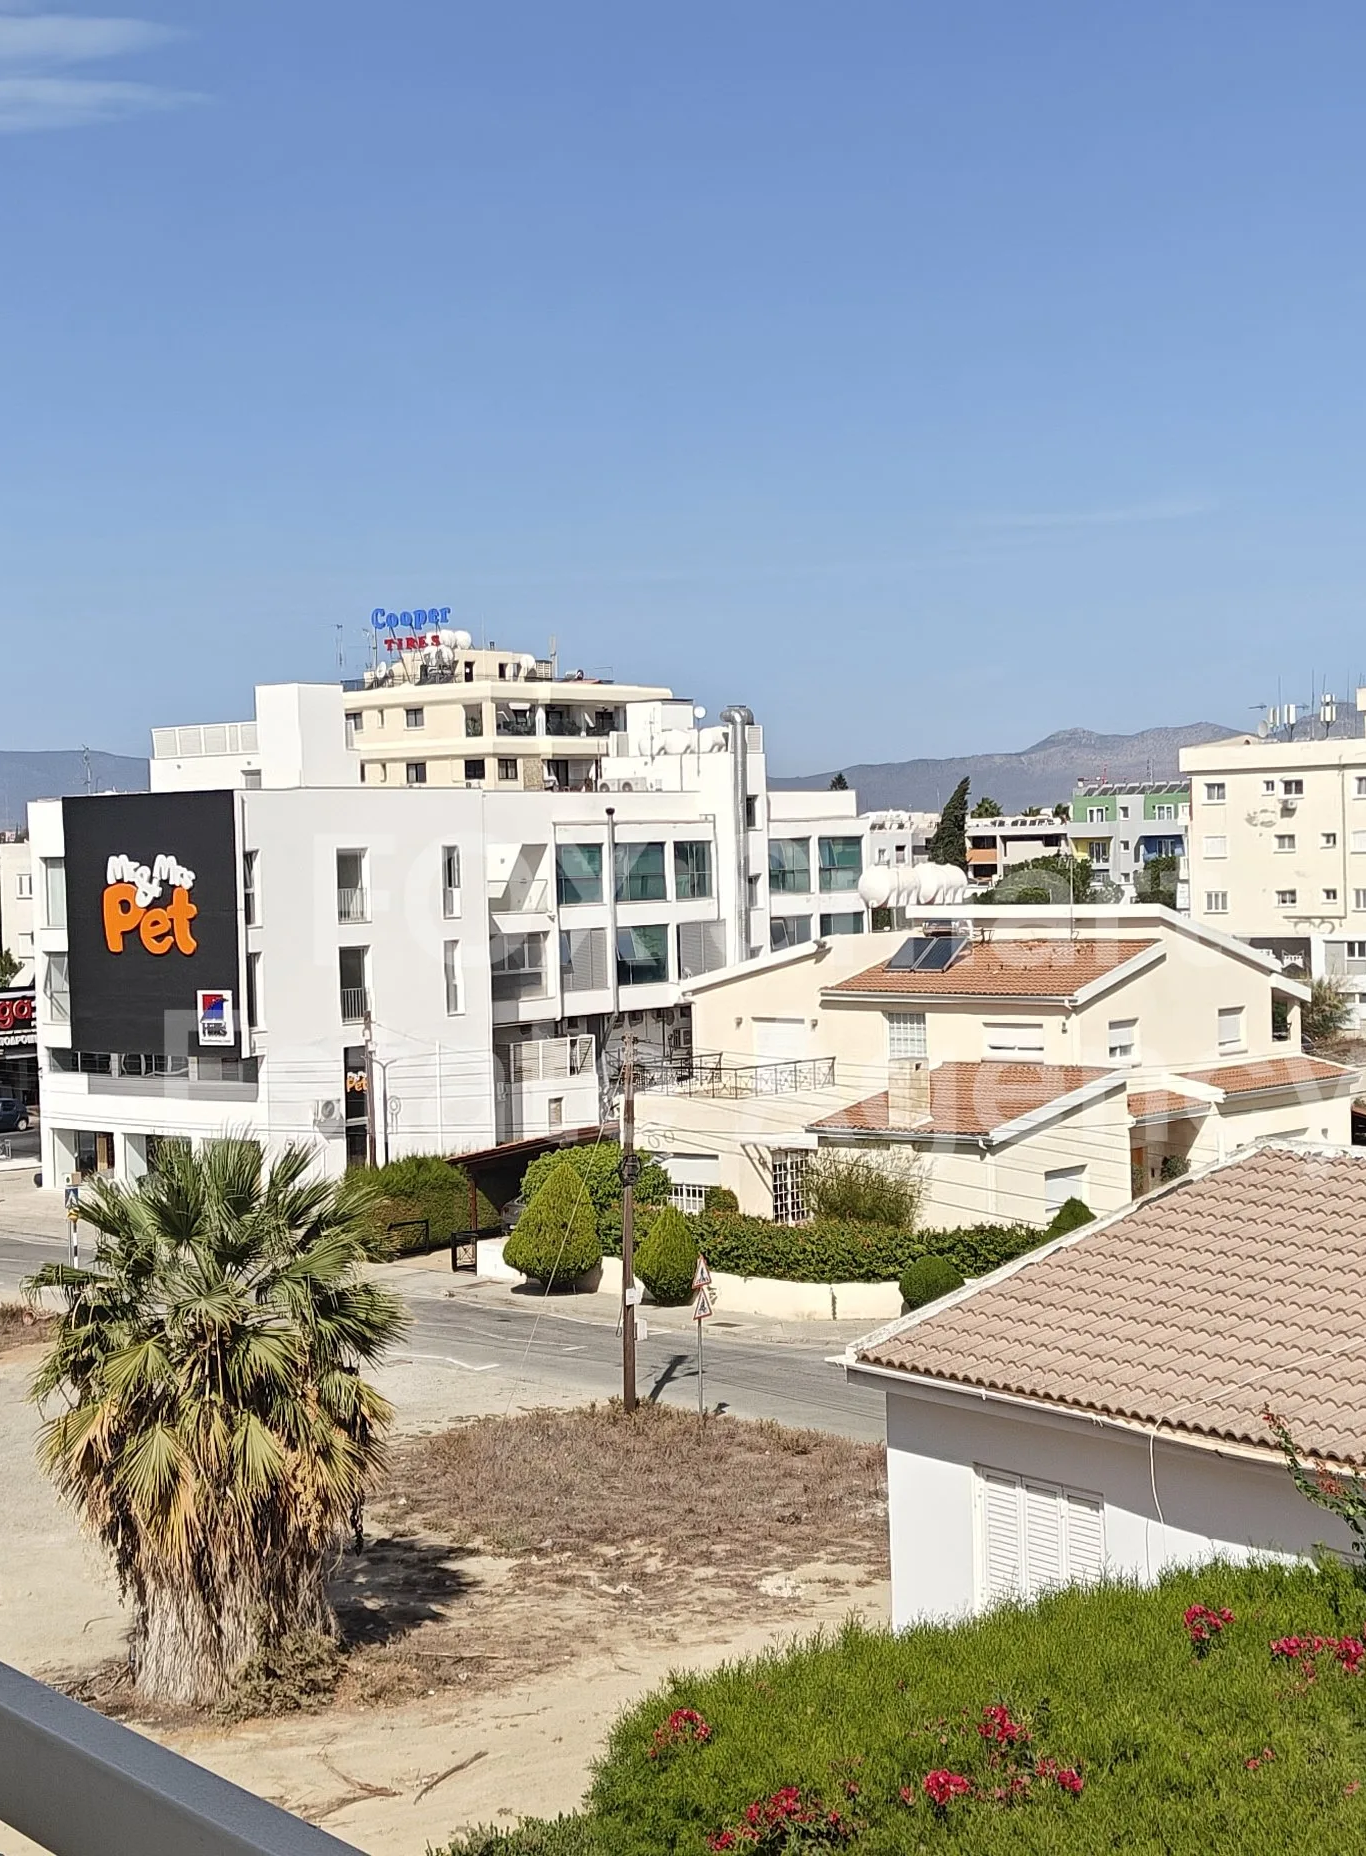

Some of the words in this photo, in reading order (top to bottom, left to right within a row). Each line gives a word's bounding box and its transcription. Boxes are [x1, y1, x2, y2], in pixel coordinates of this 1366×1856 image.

[371, 606, 451, 630] Cooper
[384, 635, 441, 651] TIRES
[103, 882, 198, 956] Pet
